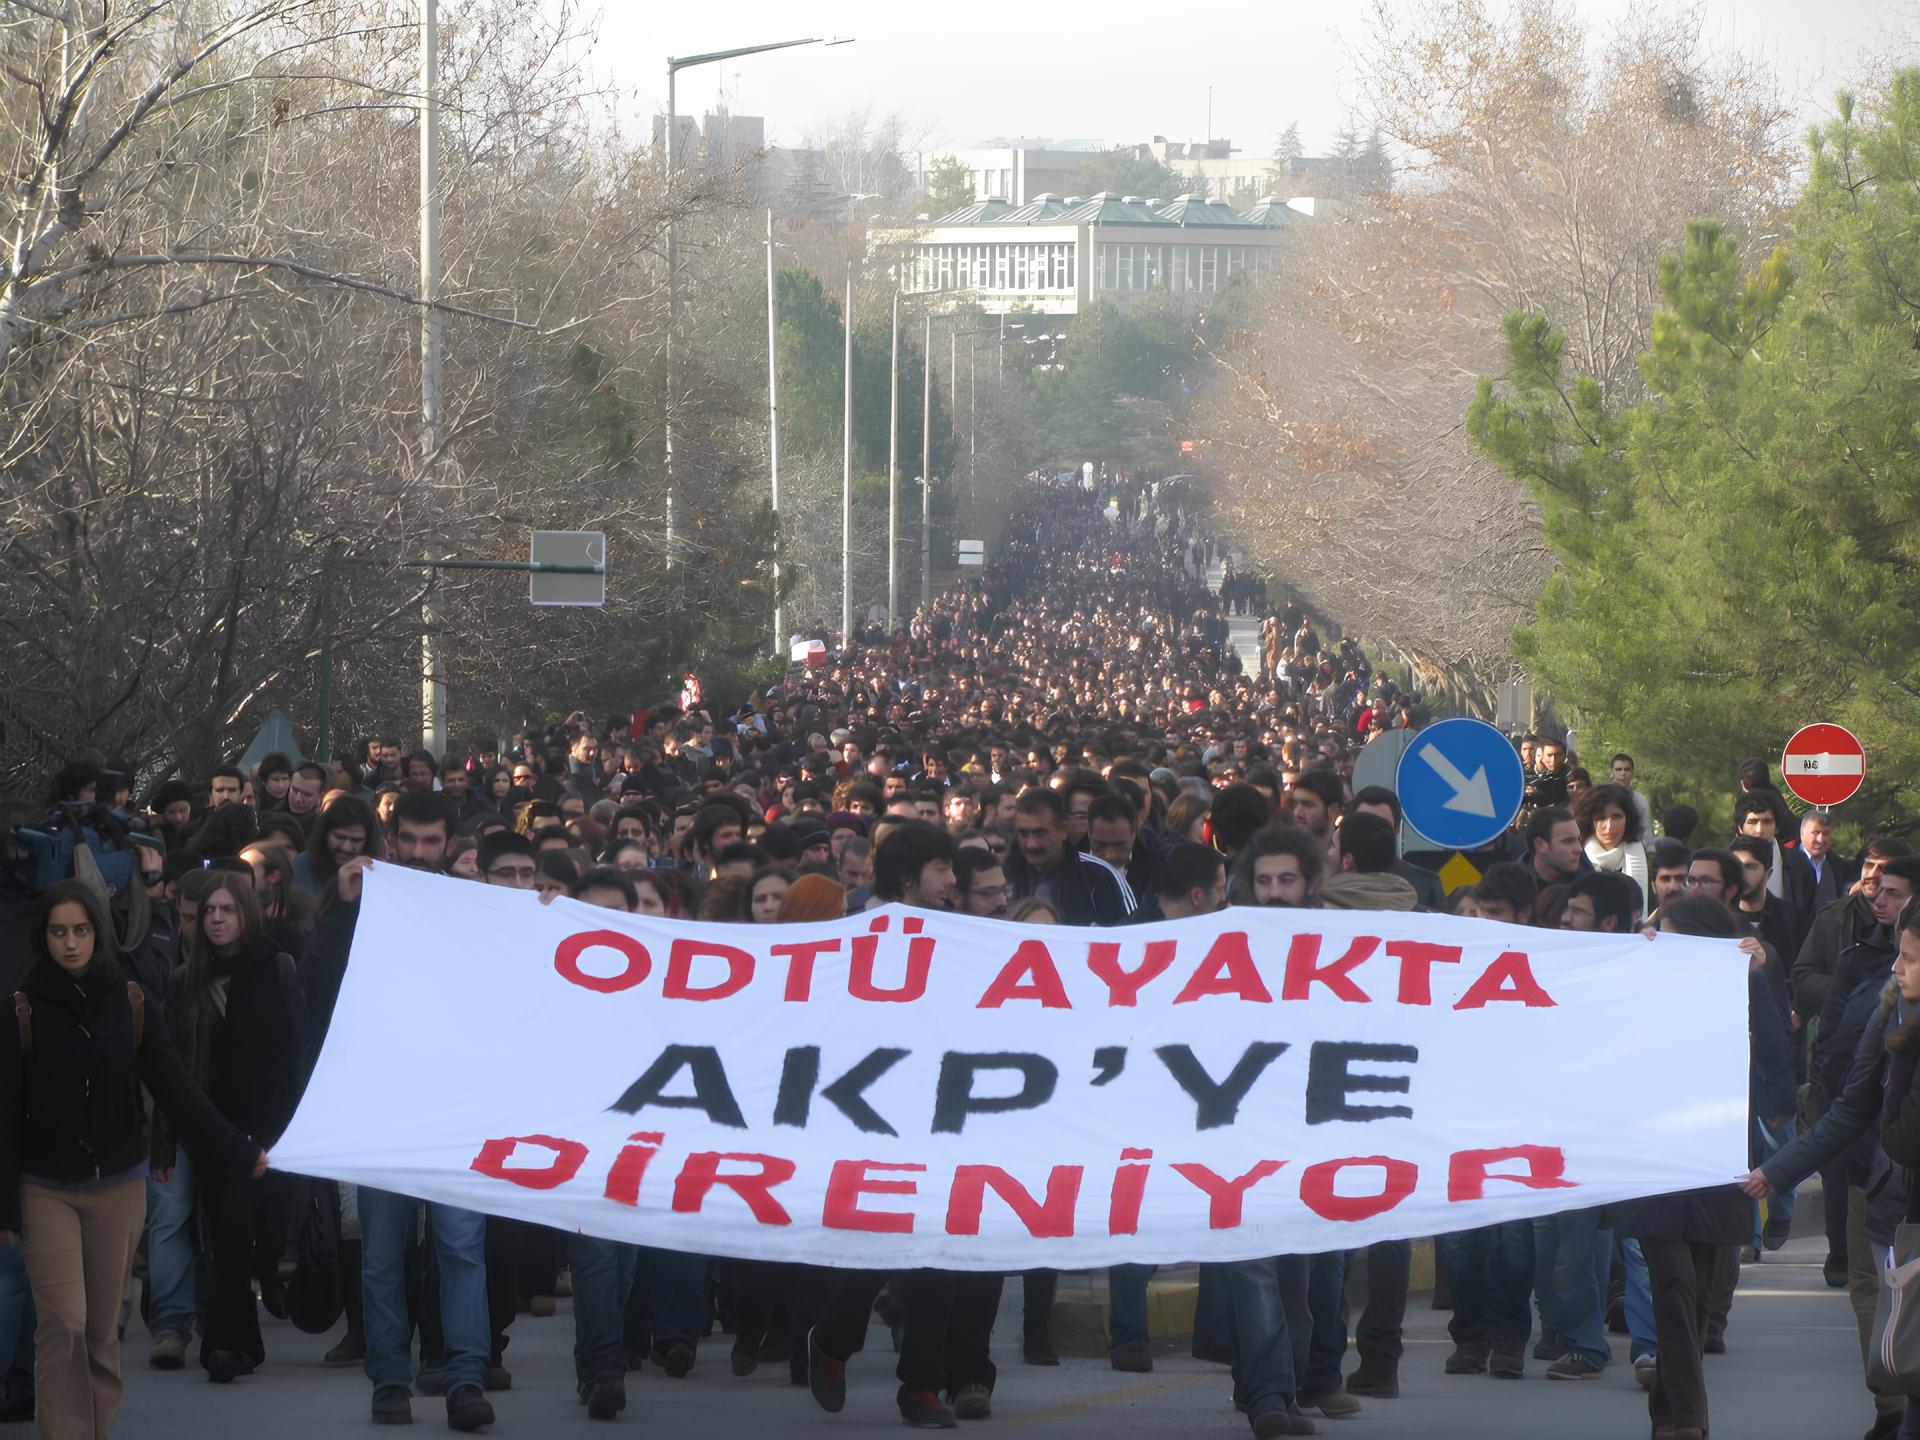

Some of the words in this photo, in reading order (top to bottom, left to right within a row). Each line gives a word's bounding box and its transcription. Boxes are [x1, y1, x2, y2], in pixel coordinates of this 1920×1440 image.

[555, 915, 936, 1002] ODTÜ
[976, 931, 1557, 1010] AYAKTA
[603, 1042, 1418, 1137] AKP'YE
[470, 1131, 1579, 1238] DİRENİYOR
